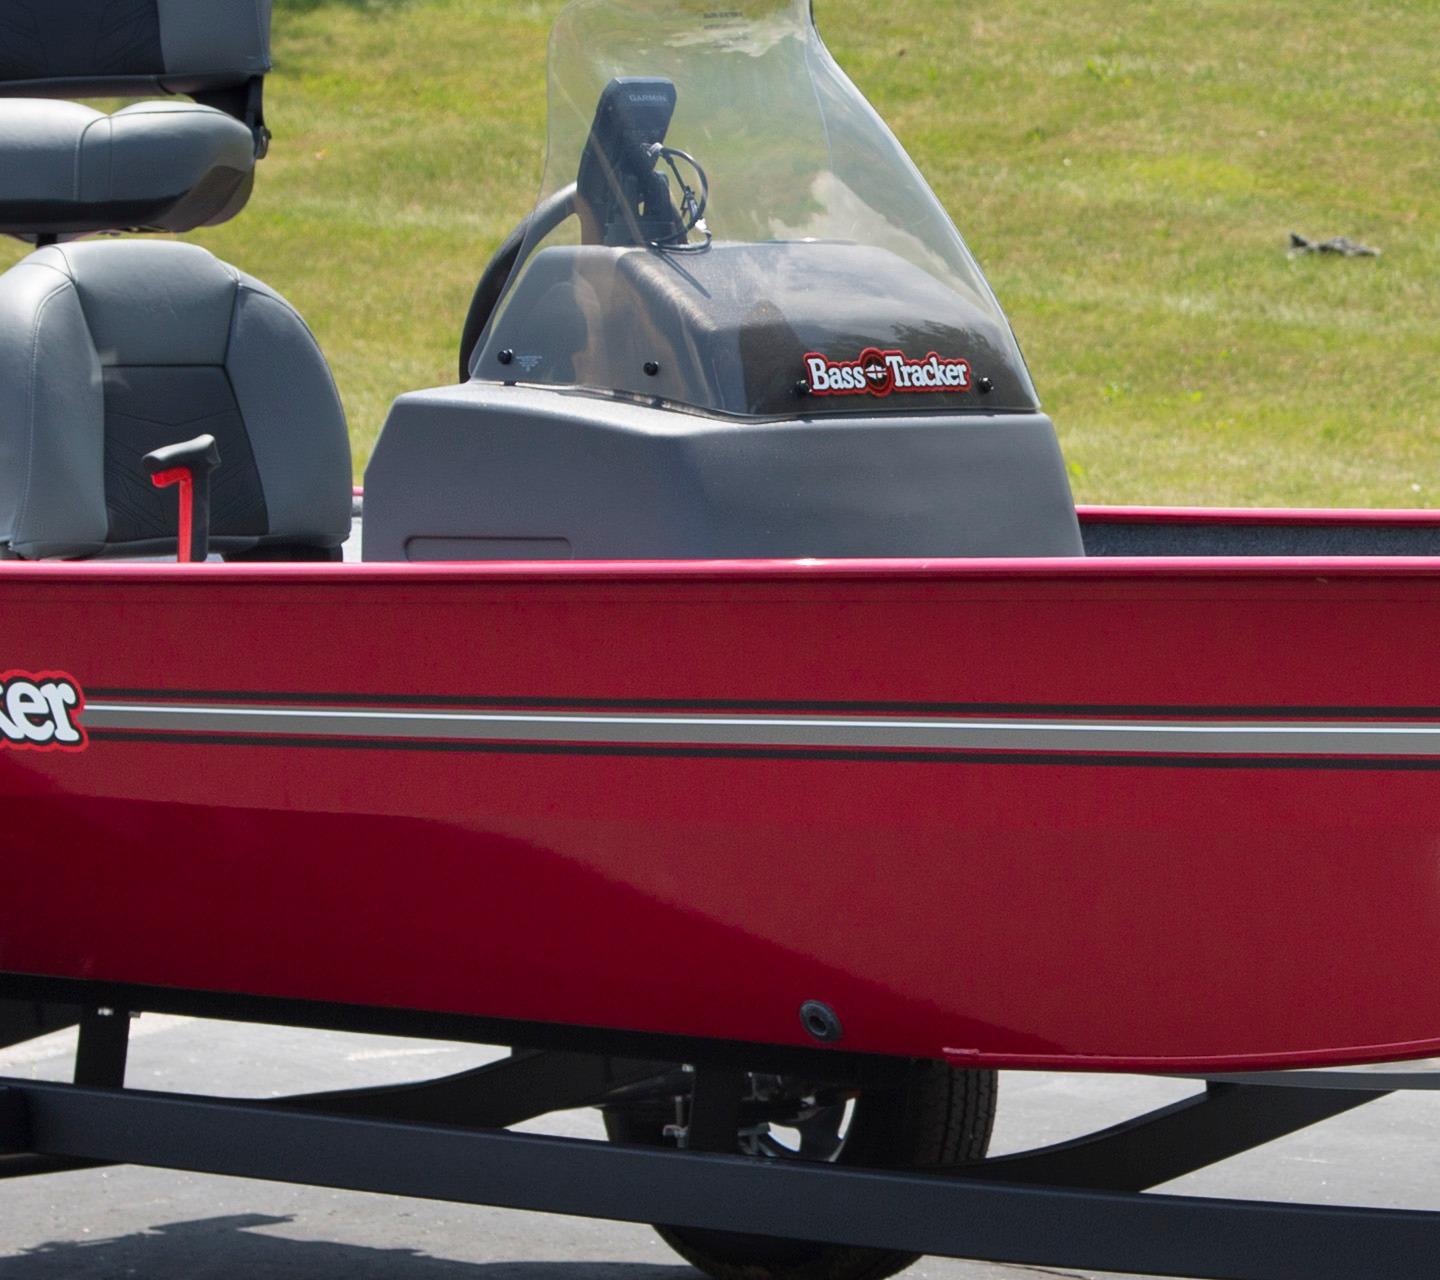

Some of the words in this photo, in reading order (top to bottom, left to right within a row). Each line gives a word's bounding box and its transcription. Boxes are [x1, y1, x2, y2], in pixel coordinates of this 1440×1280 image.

[628, 93, 667, 103] GARMIN
[807, 357, 866, 391] Bass
[885, 355, 968, 387] Tracker
